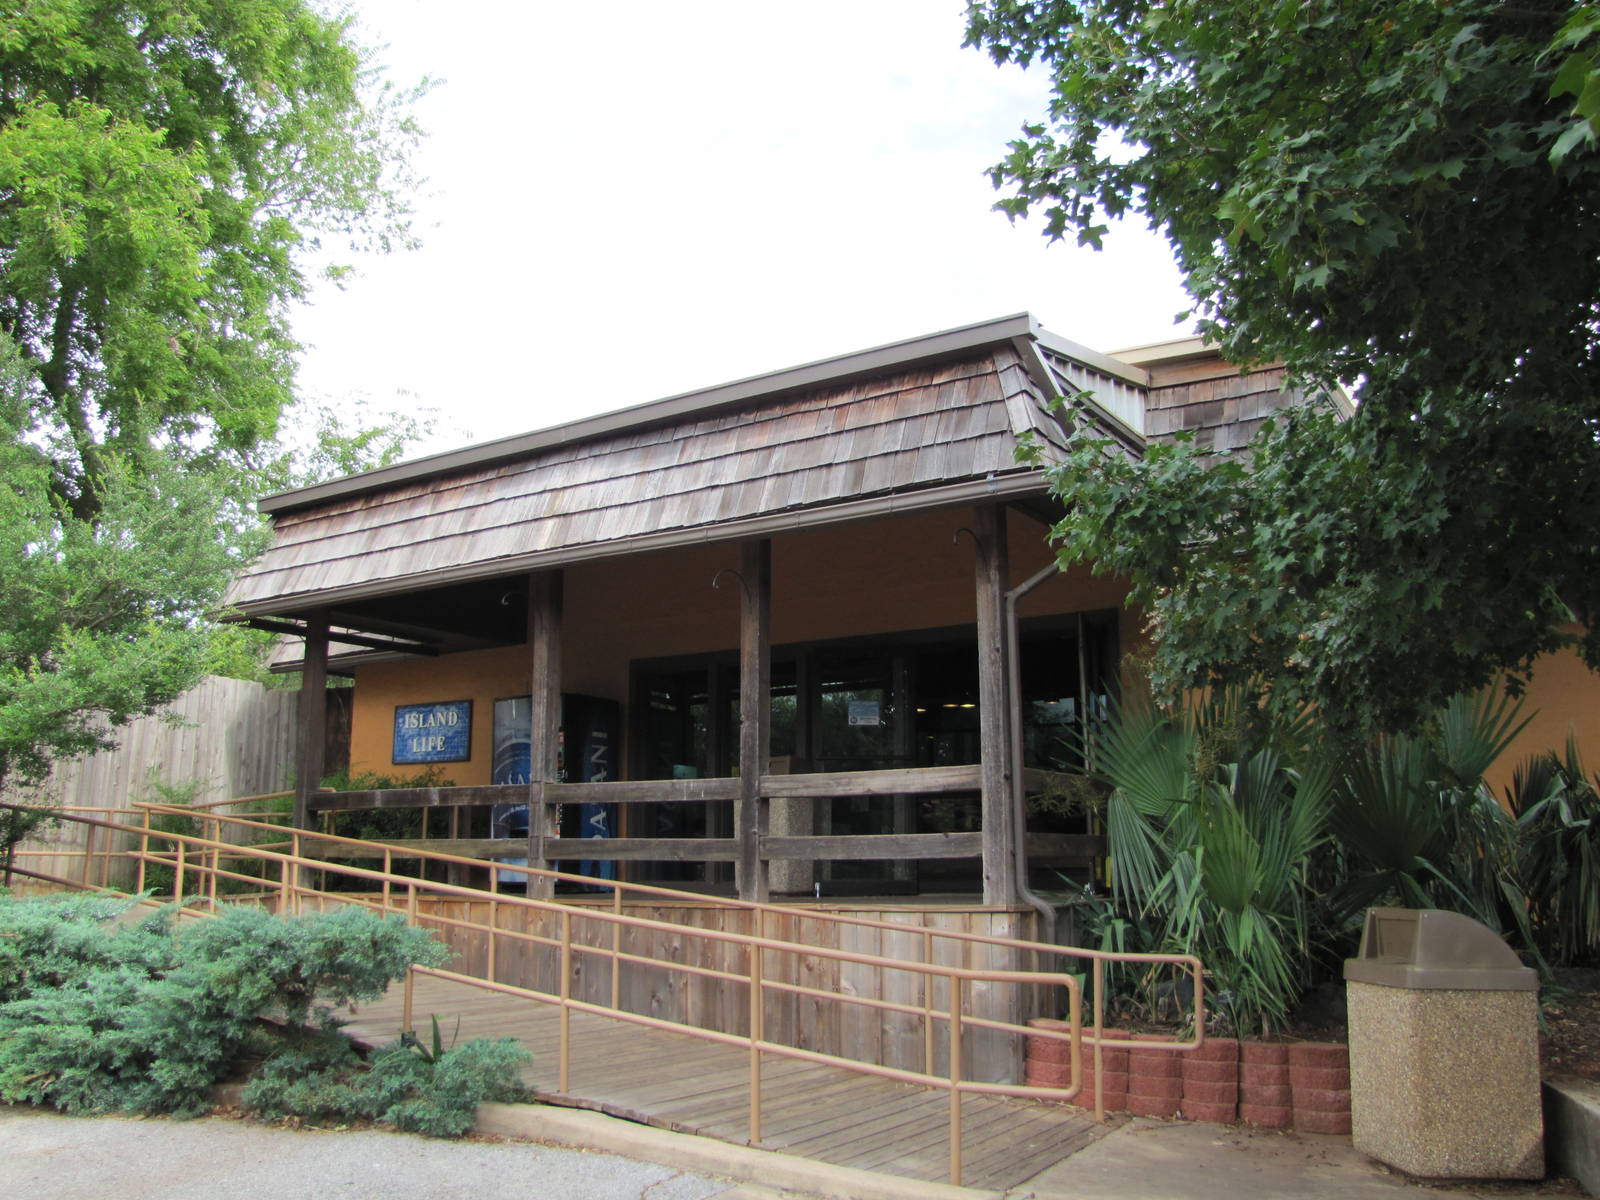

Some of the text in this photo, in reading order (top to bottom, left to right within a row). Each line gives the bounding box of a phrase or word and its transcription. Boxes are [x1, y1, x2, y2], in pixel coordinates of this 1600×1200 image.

[405, 711, 458, 729] ISLAND
[413, 736, 446, 753] LIFE
[589, 731, 609, 839] AANI
